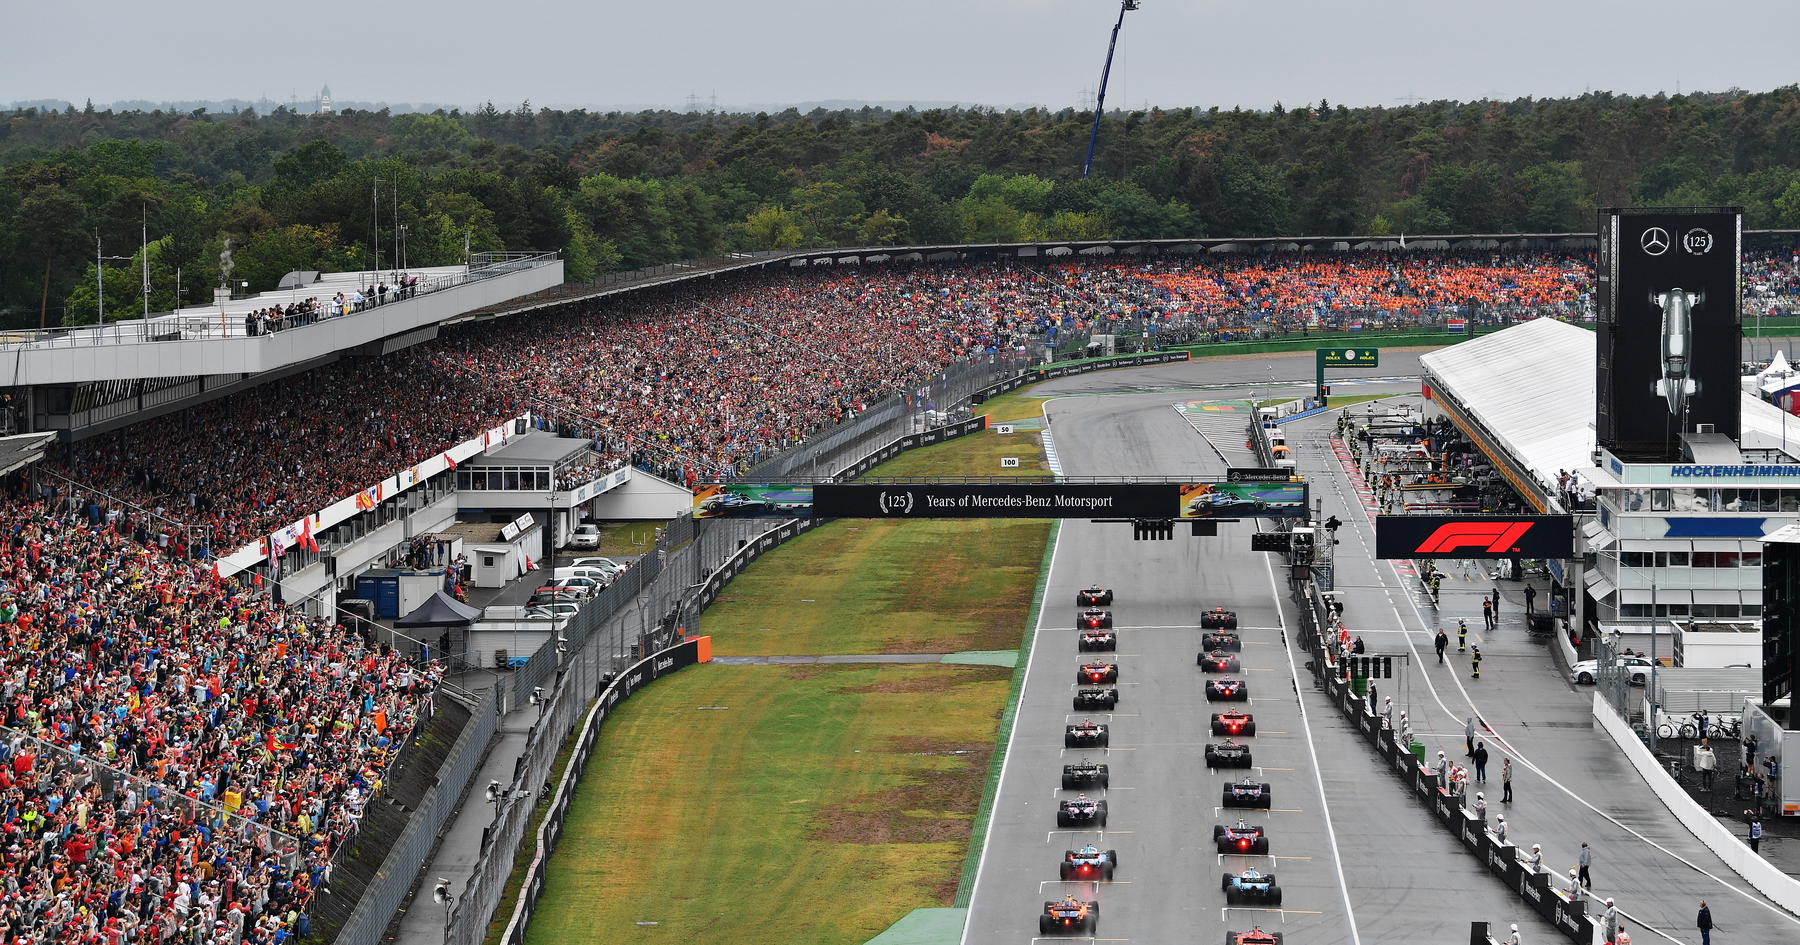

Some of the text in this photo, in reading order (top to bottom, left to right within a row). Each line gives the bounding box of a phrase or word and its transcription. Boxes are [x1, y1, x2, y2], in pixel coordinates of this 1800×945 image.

[1690, 236, 1705, 247] 125
[1671, 465, 1800, 477] HOCKENHEIMRIN
[888, 495, 1113, 510] 125 Years of Mercedes-Benz Motorsport
